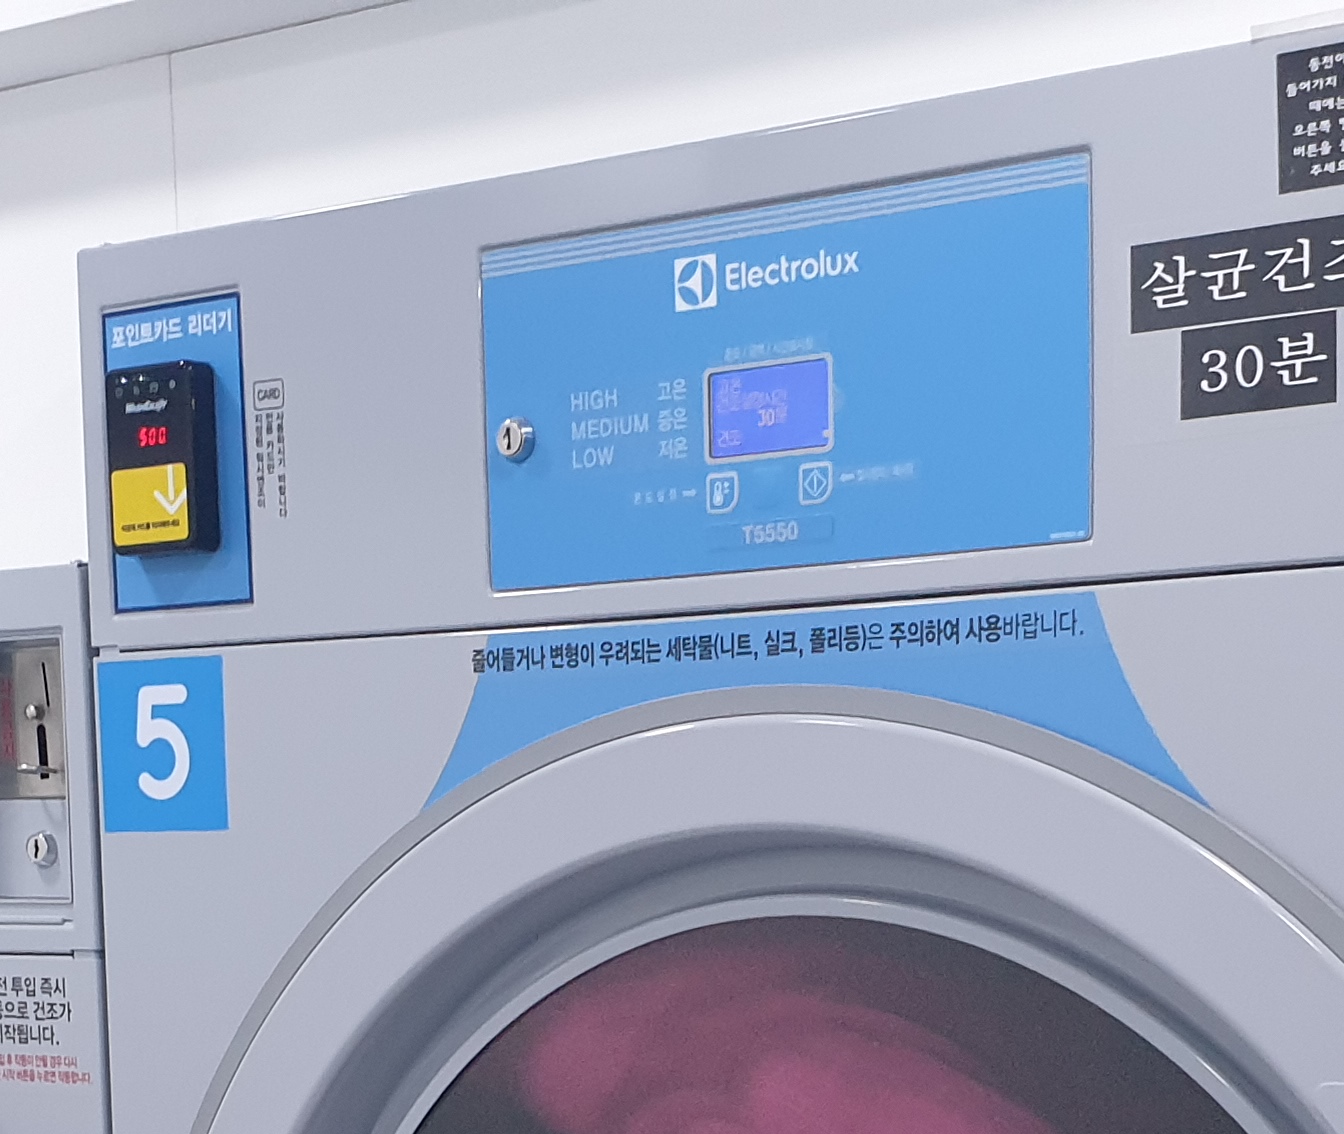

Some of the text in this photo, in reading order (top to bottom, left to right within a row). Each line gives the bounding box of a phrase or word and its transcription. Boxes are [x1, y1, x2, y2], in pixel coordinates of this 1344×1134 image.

[1286, 75, 1338, 97] 들어가지
[1293, 119, 1331, 137] 오른쪽
[1293, 140, 1332, 157] 버튼을
[725, 249, 859, 291] Electrolux
[112, 308, 233, 348] 포인트카드 리더기
[1199, 332, 1328, 393] 30분
[257, 388, 281, 401] CARD
[570, 378, 687, 411] HIGH 고온
[138, 427, 167, 448] 500
[570, 407, 688, 441] MEDIUM 중온
[571, 445, 615, 470] LOW
[658, 436, 688, 461] 저온
[742, 520, 799, 545] T5550
[471, 608, 1085, 673] 줄어들거나 변형이 우려되는 세탁물(니트, 실크, 폴리등)은 주의하여 사용바랍니다.
[136, 683, 191, 801] 5
[11, 977, 37, 997] 투입
[40, 978, 66, 998] 즉시
[33, 1001, 72, 1022] 건조가
